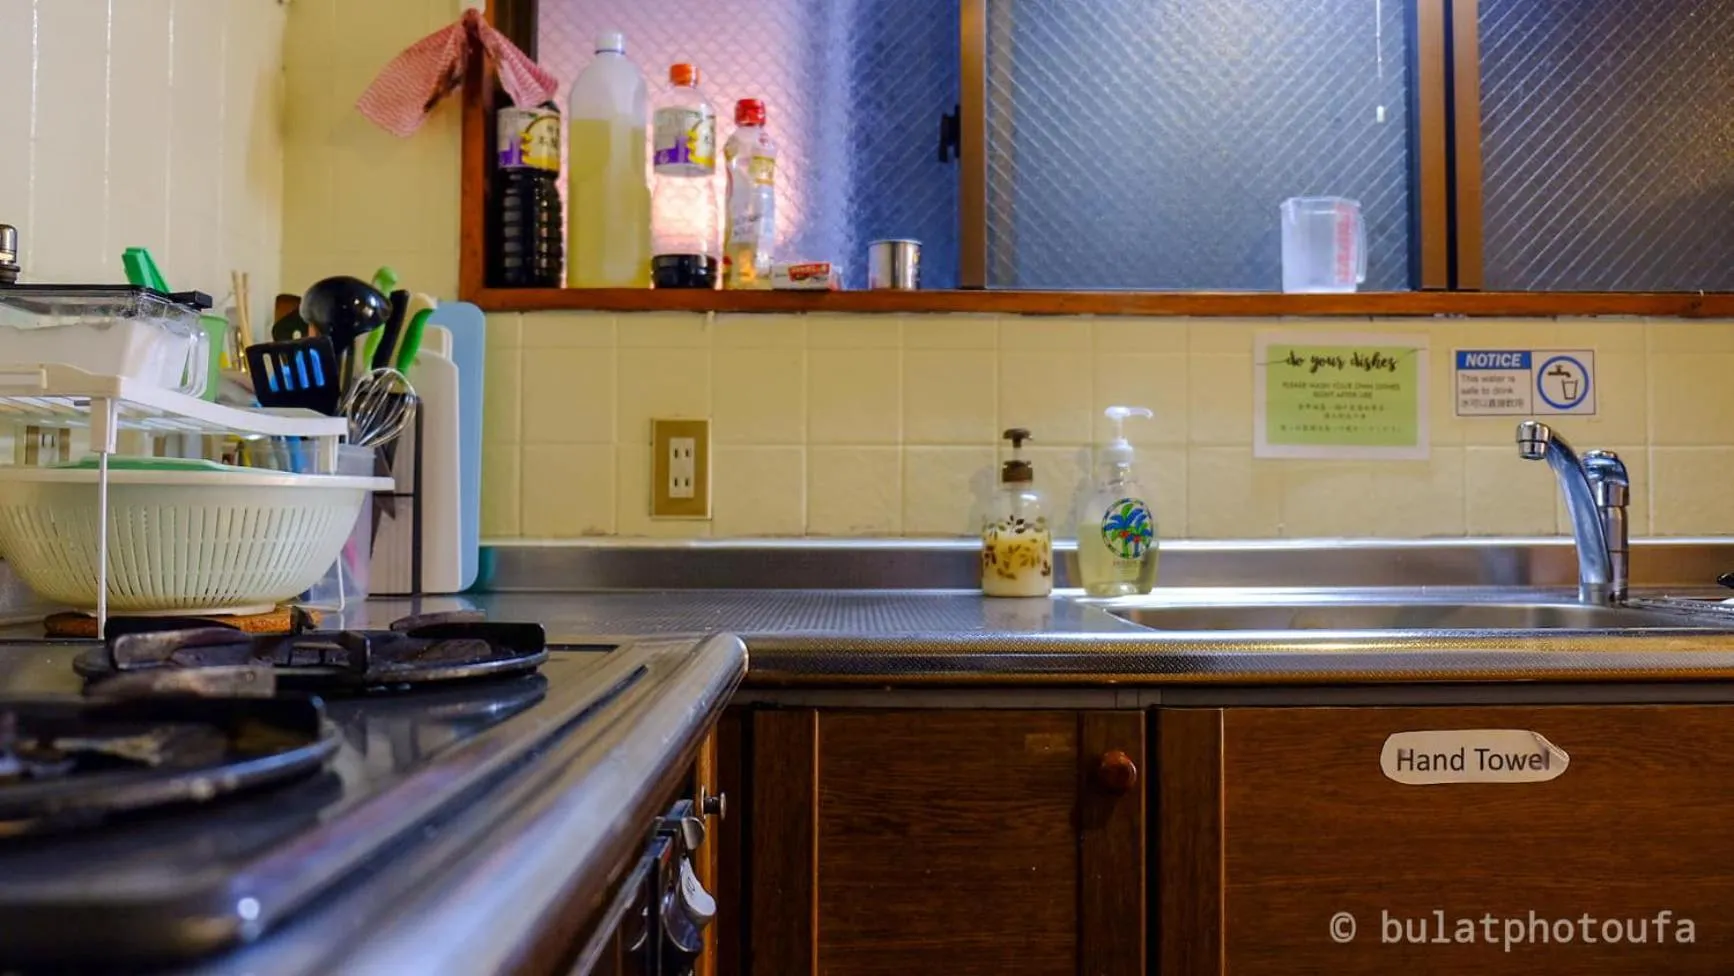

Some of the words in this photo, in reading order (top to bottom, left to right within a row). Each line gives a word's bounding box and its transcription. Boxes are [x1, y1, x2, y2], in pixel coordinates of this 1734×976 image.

[1285, 350, 1304, 366] do
[1309, 355, 1344, 373] your
[1350, 352, 1398, 372] dishes
[1465, 353, 1522, 367] NOTICE
[1461, 374, 1479, 383] This
[1481, 374, 1506, 383] water
[1336, 391, 1357, 399] AFTER
[1461, 386, 1479, 395] safe
[1481, 386, 1490, 395] to
[1492, 386, 1514, 395] drink
[1396, 746, 1465, 772] Hand
[1473, 747, 1550, 772] Towel
